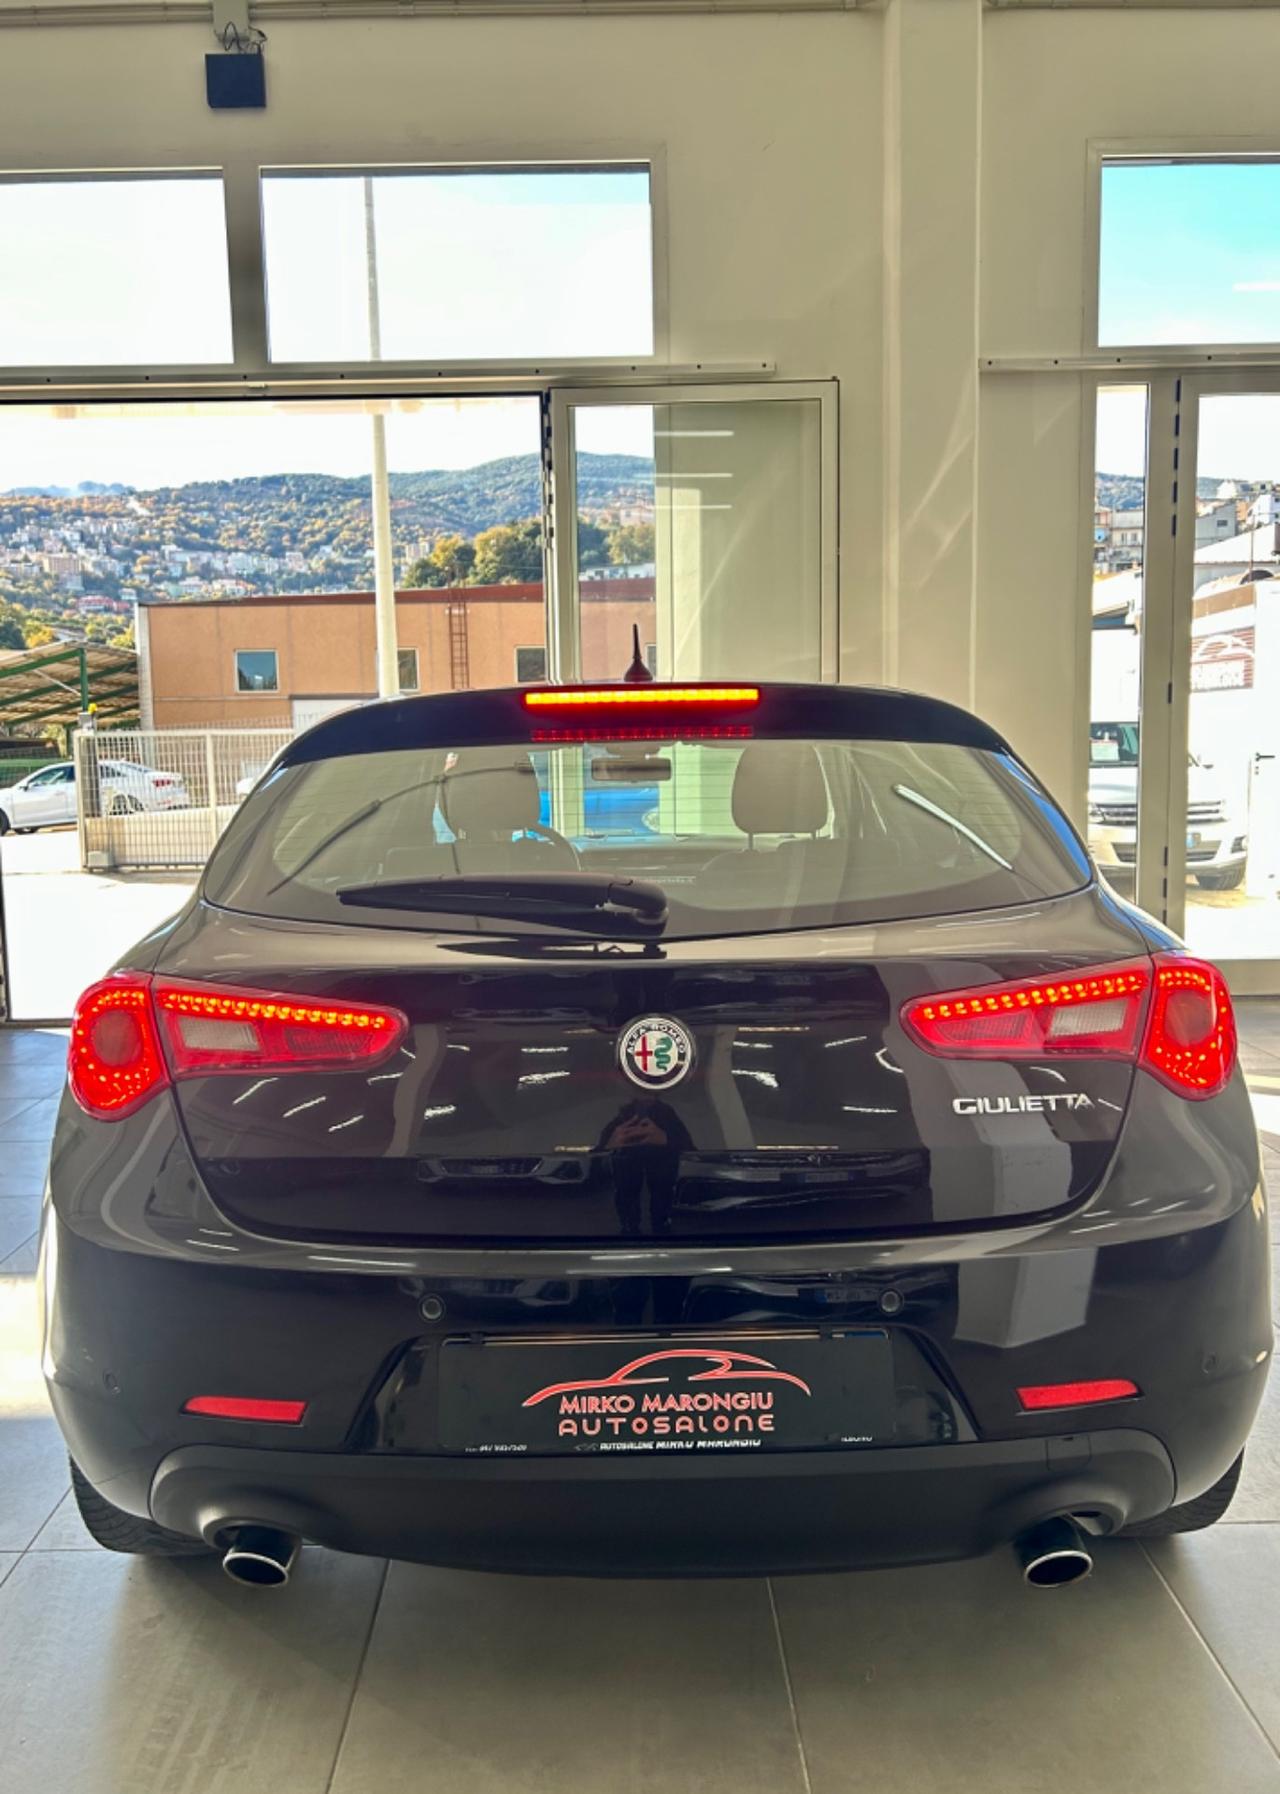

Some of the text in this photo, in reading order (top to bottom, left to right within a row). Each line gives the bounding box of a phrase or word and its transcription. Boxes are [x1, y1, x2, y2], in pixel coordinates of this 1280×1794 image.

[952, 1093, 1095, 1115] GIULIETTA
[559, 1391, 774, 1414] MIRKO MARONGIU
[558, 1413, 775, 1437] AUTOSALONE
